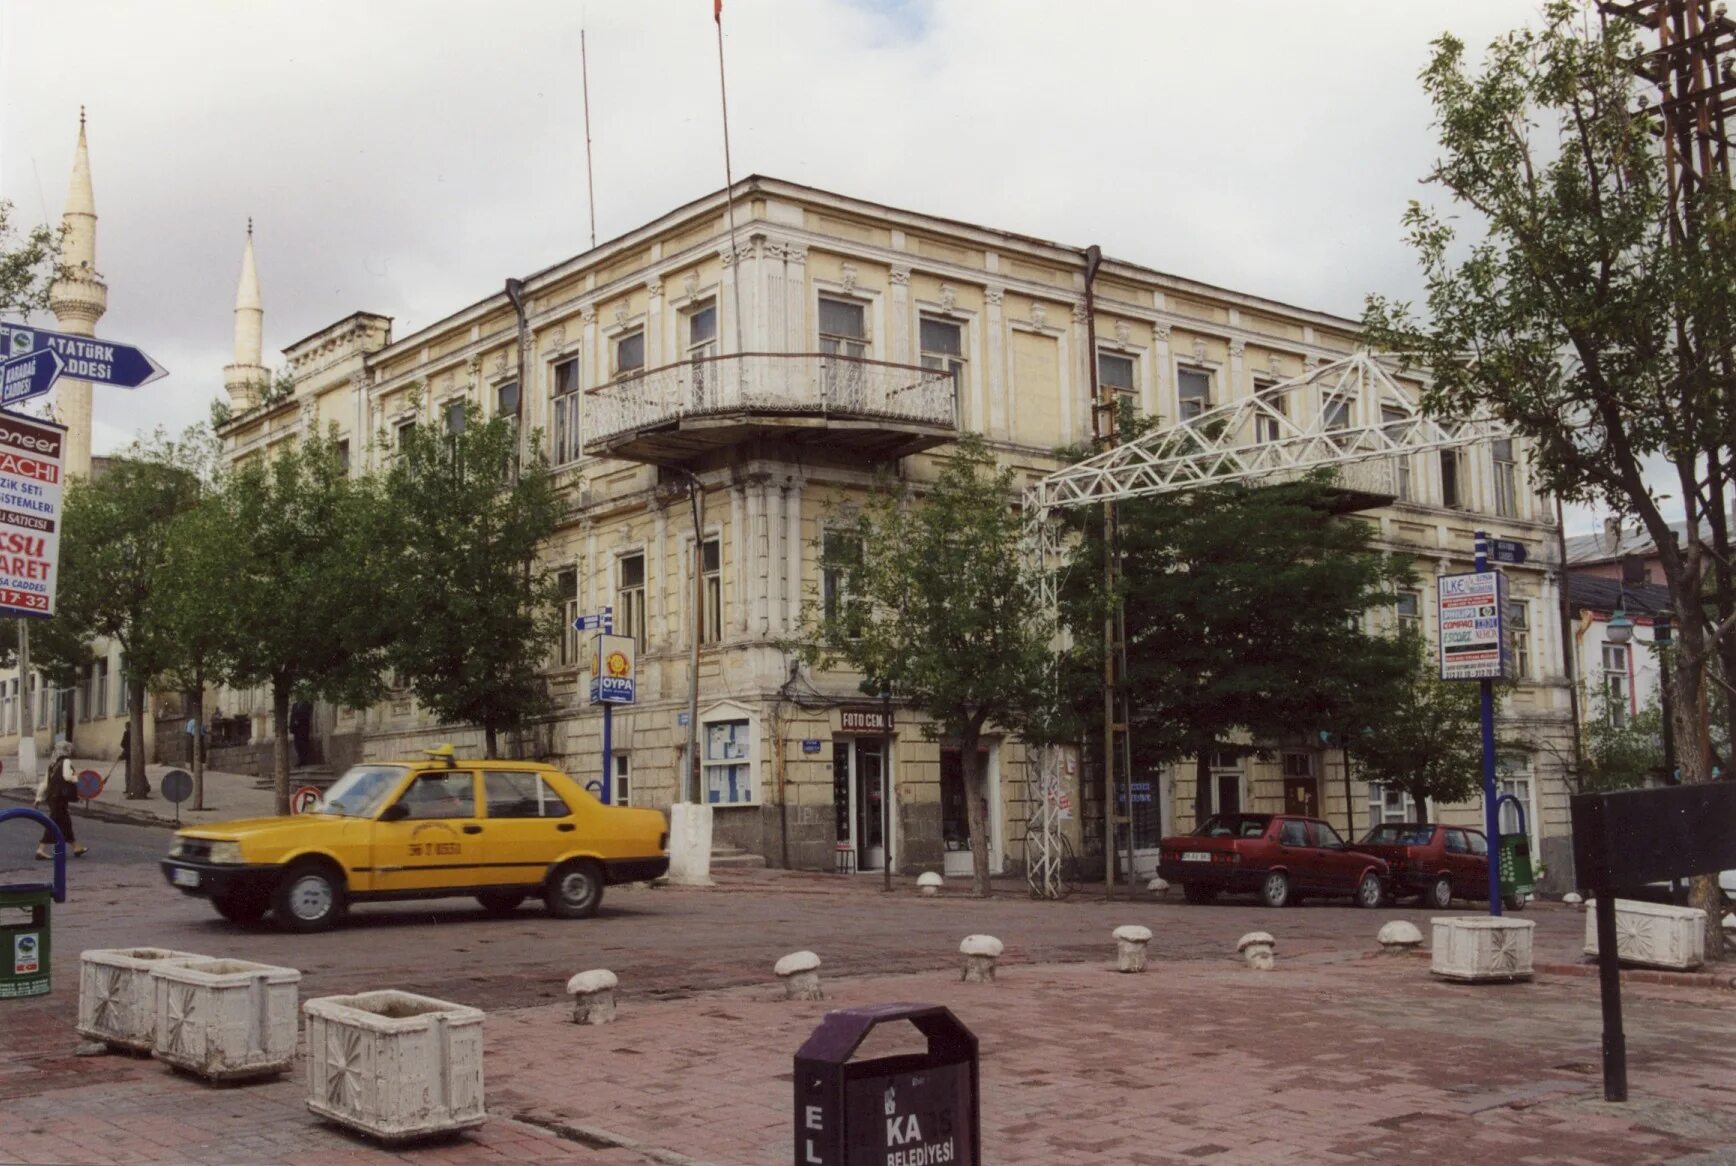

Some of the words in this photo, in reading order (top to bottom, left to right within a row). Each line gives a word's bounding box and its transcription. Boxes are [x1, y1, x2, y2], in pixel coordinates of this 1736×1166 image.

[63, 357, 111, 379] DDESİ
[21, 482, 43, 497] SETİ
[25, 594, 46, 609] 32
[603, 677, 632, 691] OYPA
[843, 712, 865, 727] FOTO
[865, 713, 893, 728] CEML
[887, 1136, 954, 1166] BELEDİYESİ
